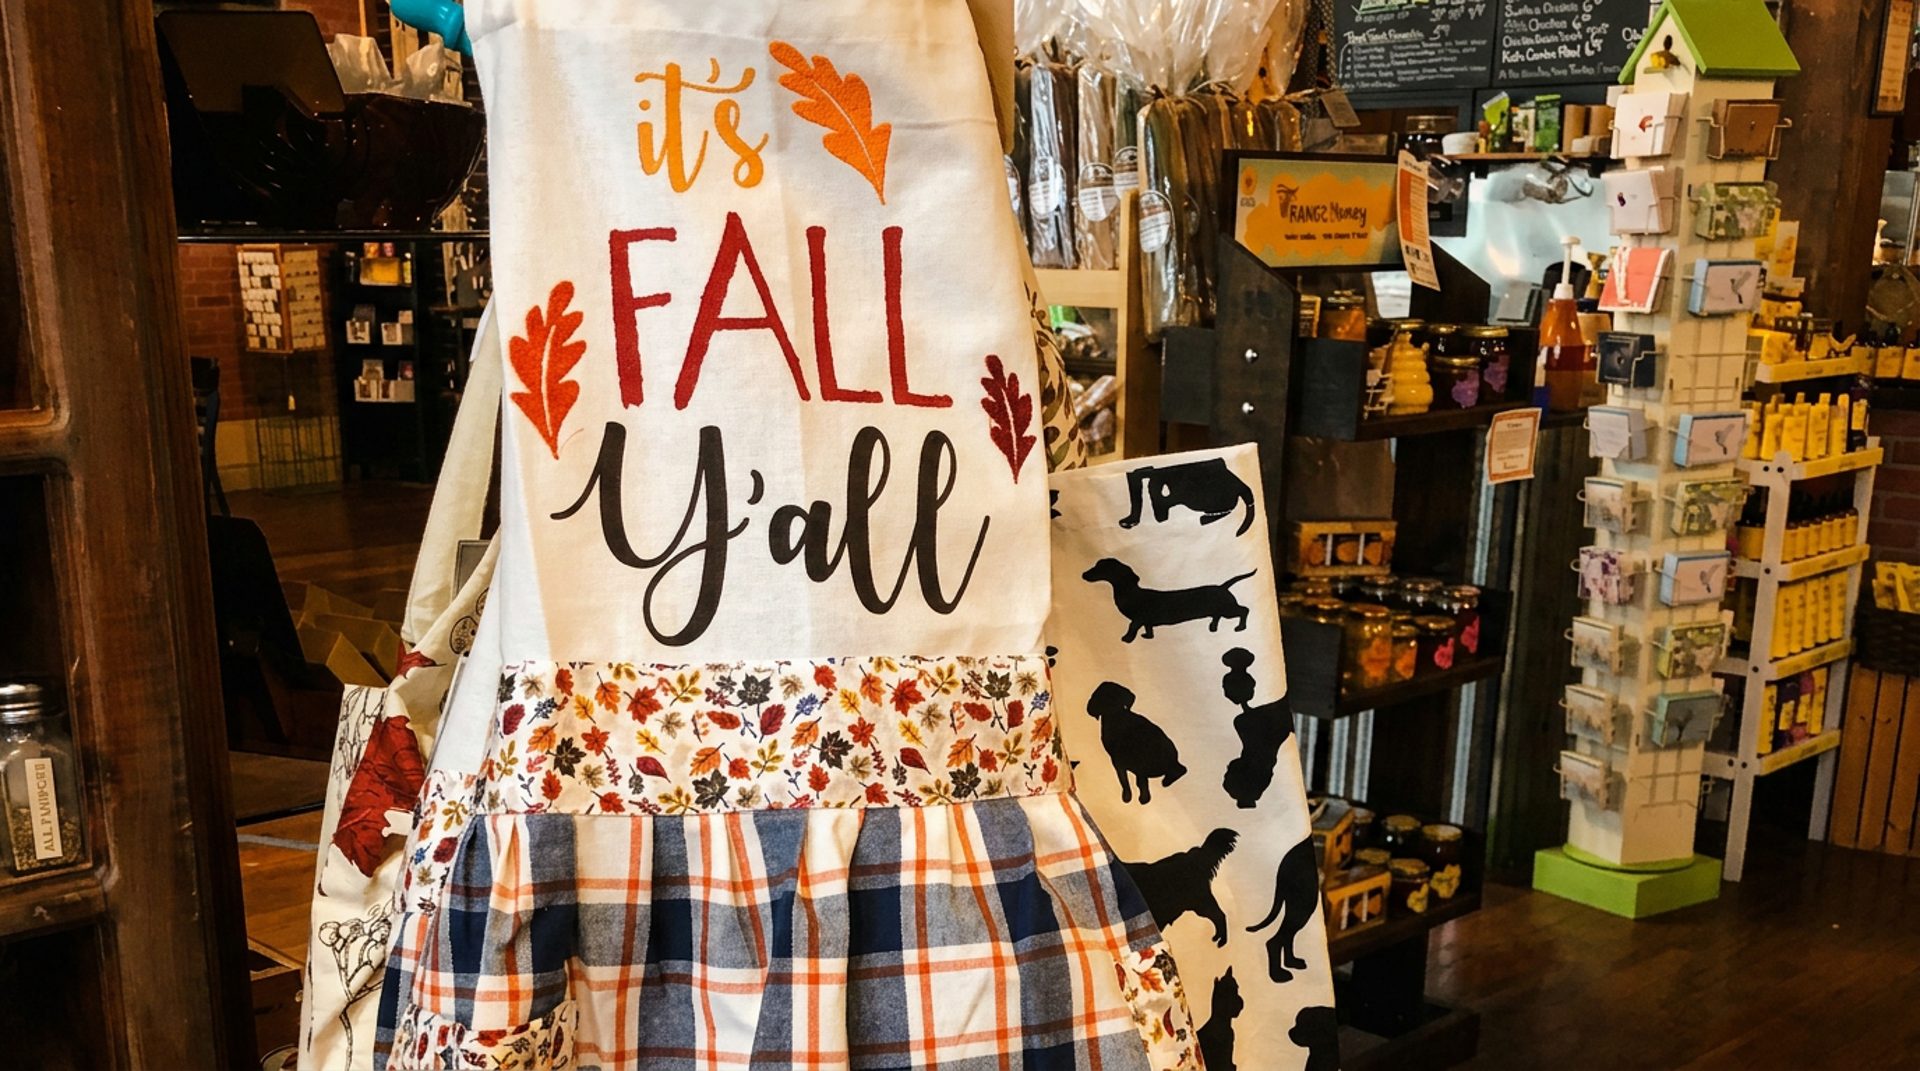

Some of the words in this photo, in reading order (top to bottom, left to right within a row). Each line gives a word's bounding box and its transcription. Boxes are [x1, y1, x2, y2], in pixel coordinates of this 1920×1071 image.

[634, 58, 769, 193] it's
[609, 211, 953, 411] FALL
[550, 421, 991, 648] Y'all
